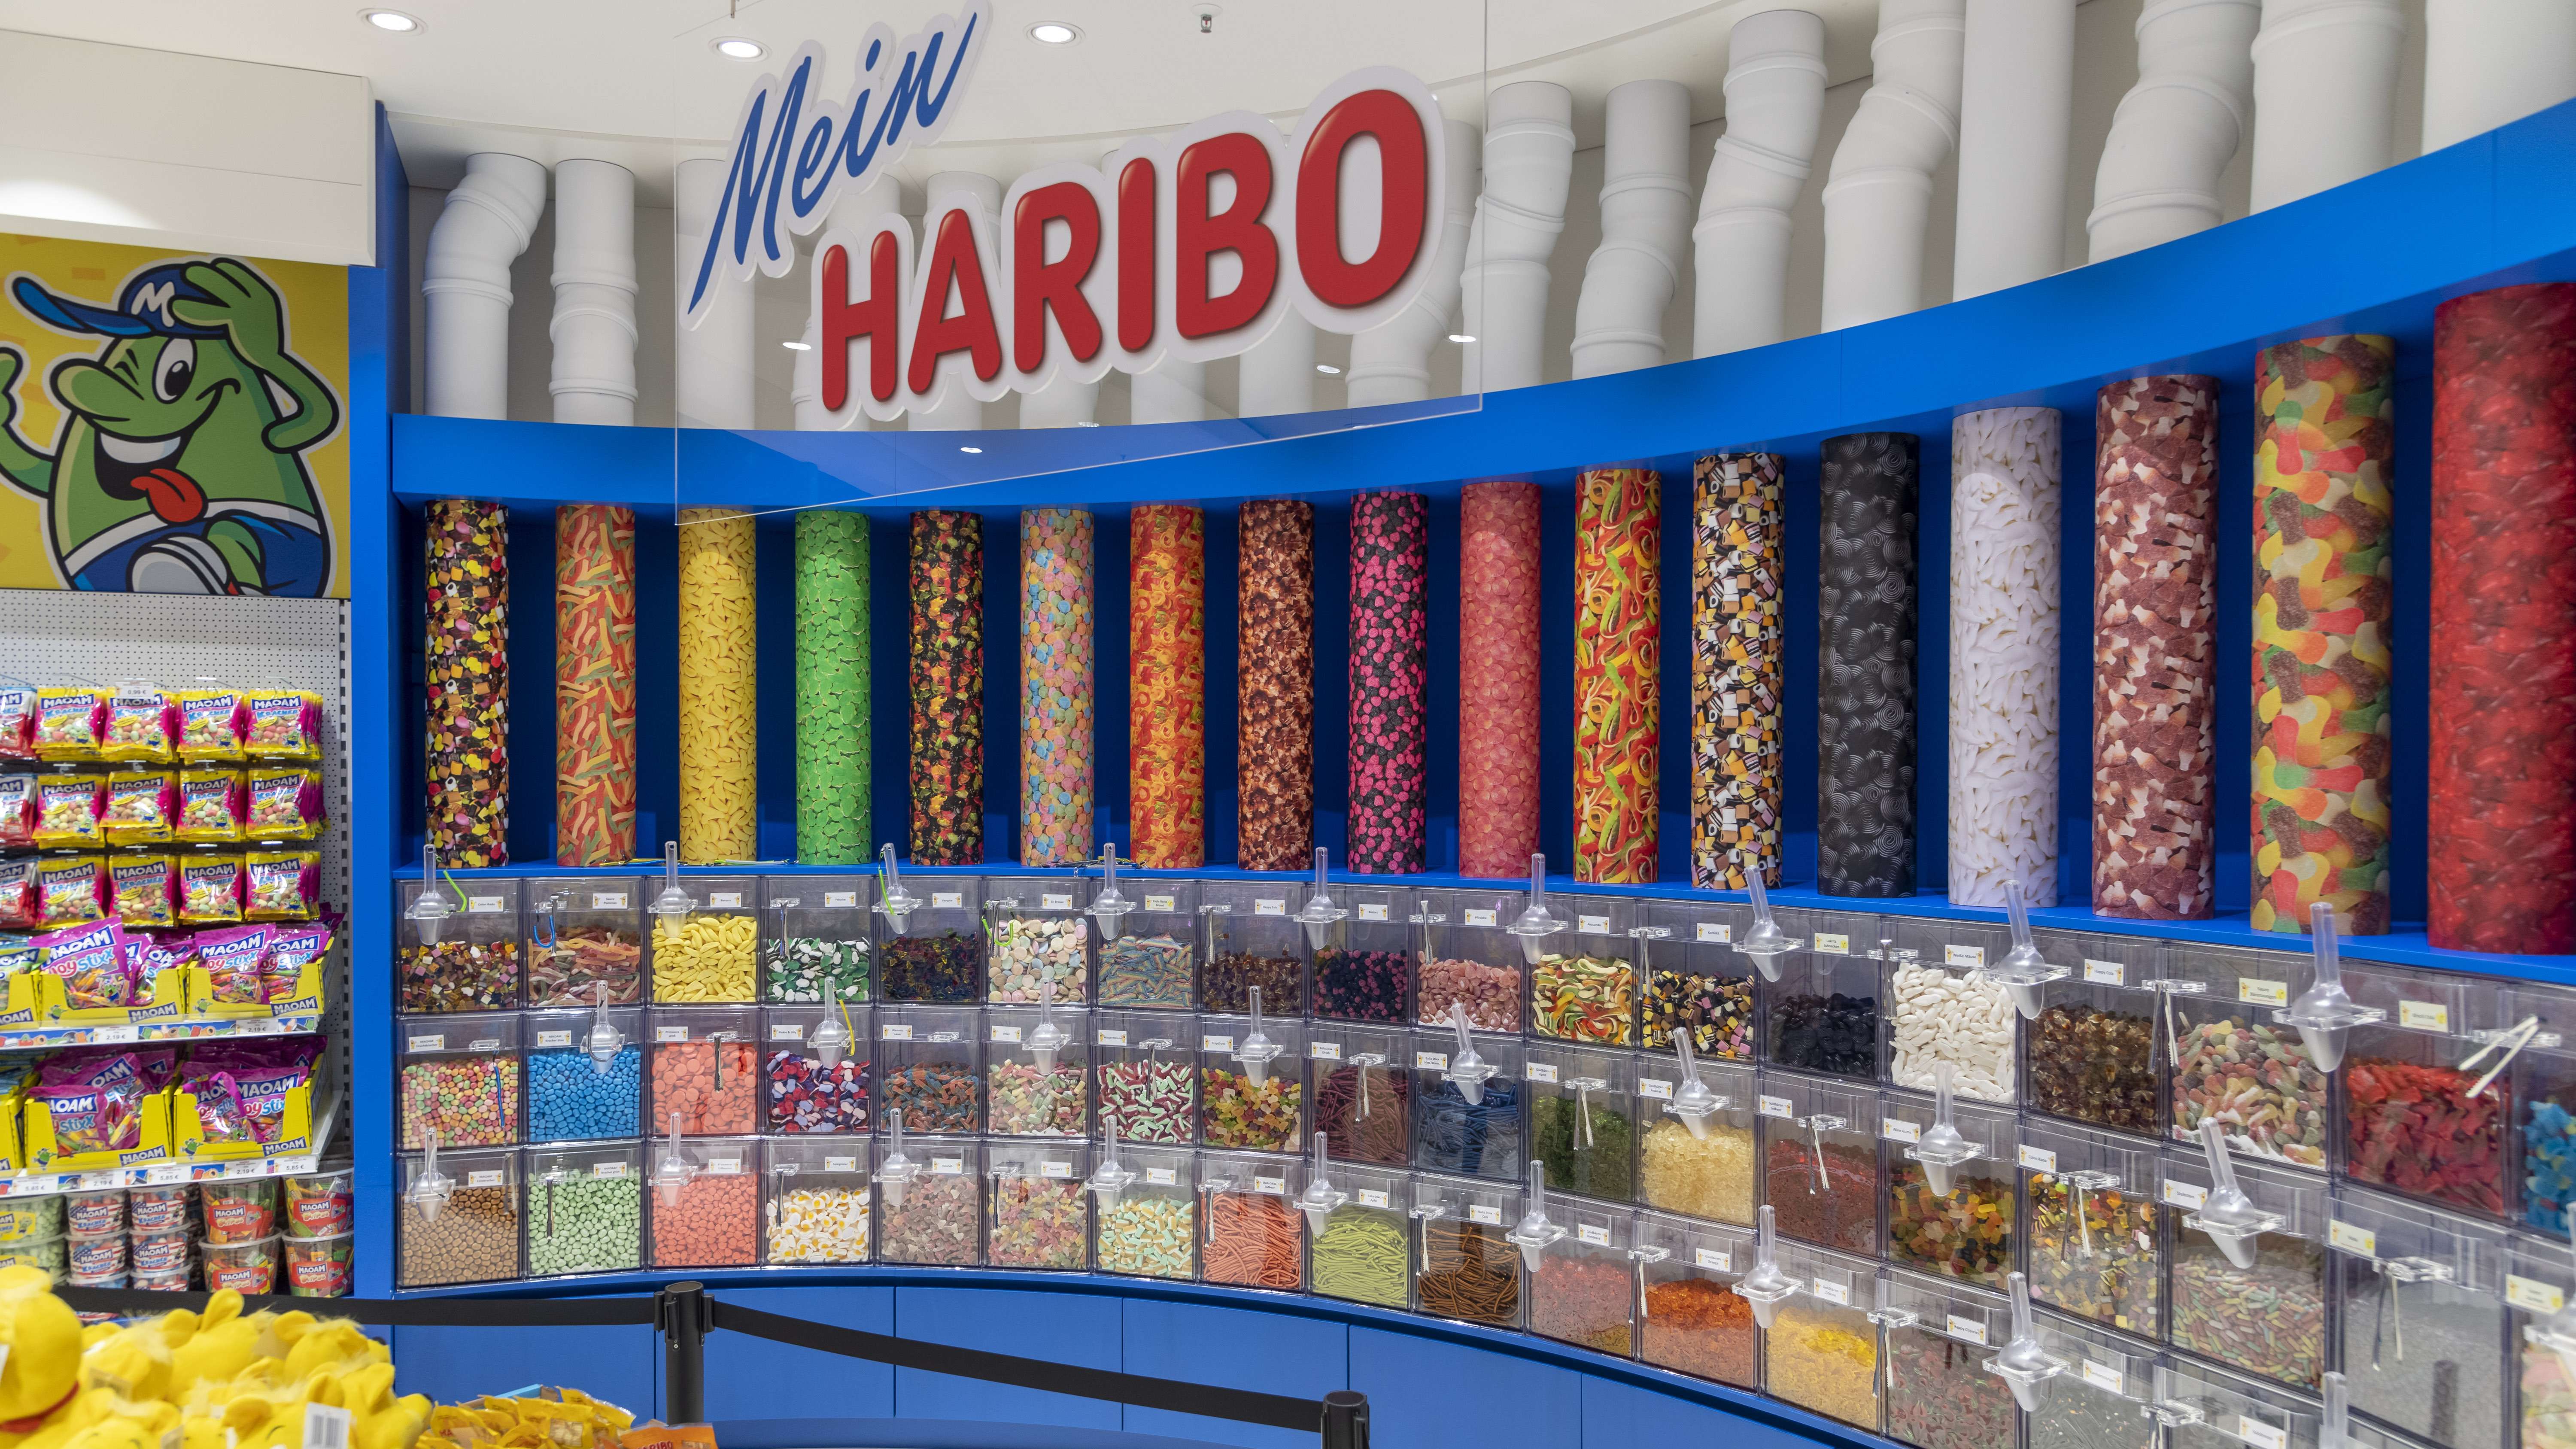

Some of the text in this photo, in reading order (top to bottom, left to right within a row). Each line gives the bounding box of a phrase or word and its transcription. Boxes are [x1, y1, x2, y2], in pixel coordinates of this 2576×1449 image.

[688, 12, 976, 316] Mein
[822, 89, 1426, 412] HARIBO
[45, 695, 94, 708] MAOAM
[113, 694, 163, 707] MAOAM
[186, 696, 232, 711] MAOAM
[255, 697, 299, 710] MAOAM
[45, 781, 94, 796] MAOAM
[115, 778, 162, 791] MAOAM
[187, 778, 228, 793] MAOAM
[255, 776, 298, 791] MAOAM
[45, 864, 93, 883] MAOAM
[117, 863, 165, 879] MAOAM
[188, 864, 234, 880] MAOAM
[254, 860, 298, 875] MAOAM
[46, 930, 111, 965] MAOAM
[202, 935, 260, 958] MAOAM
[268, 938, 315, 954] AOAM
[0, 949, 37, 967] OAM
[131, 1004, 175, 1021] MAOAM
[273, 999, 315, 1015] MAOAM
[0, 1010, 31, 1024] OAM
[91, 1063, 130, 1088] OAM
[239, 1076, 295, 1098] MAOAM
[50, 1097, 93, 1113] AOAM
[123, 1147, 164, 1163] MAOAM
[265, 1139, 305, 1156] MAOAM
[76, 1207, 108, 1220] MAOAM
[137, 1203, 166, 1215] MAOAM
[216, 1206, 244, 1218] MAOAM
[301, 1201, 330, 1211] MAOAM
[81, 1249, 112, 1264] MAOAM
[139, 1245, 168, 1258] MAOAM
[298, 1262, 326, 1274] MAOAM
[221, 1270, 250, 1282] MAOAM
